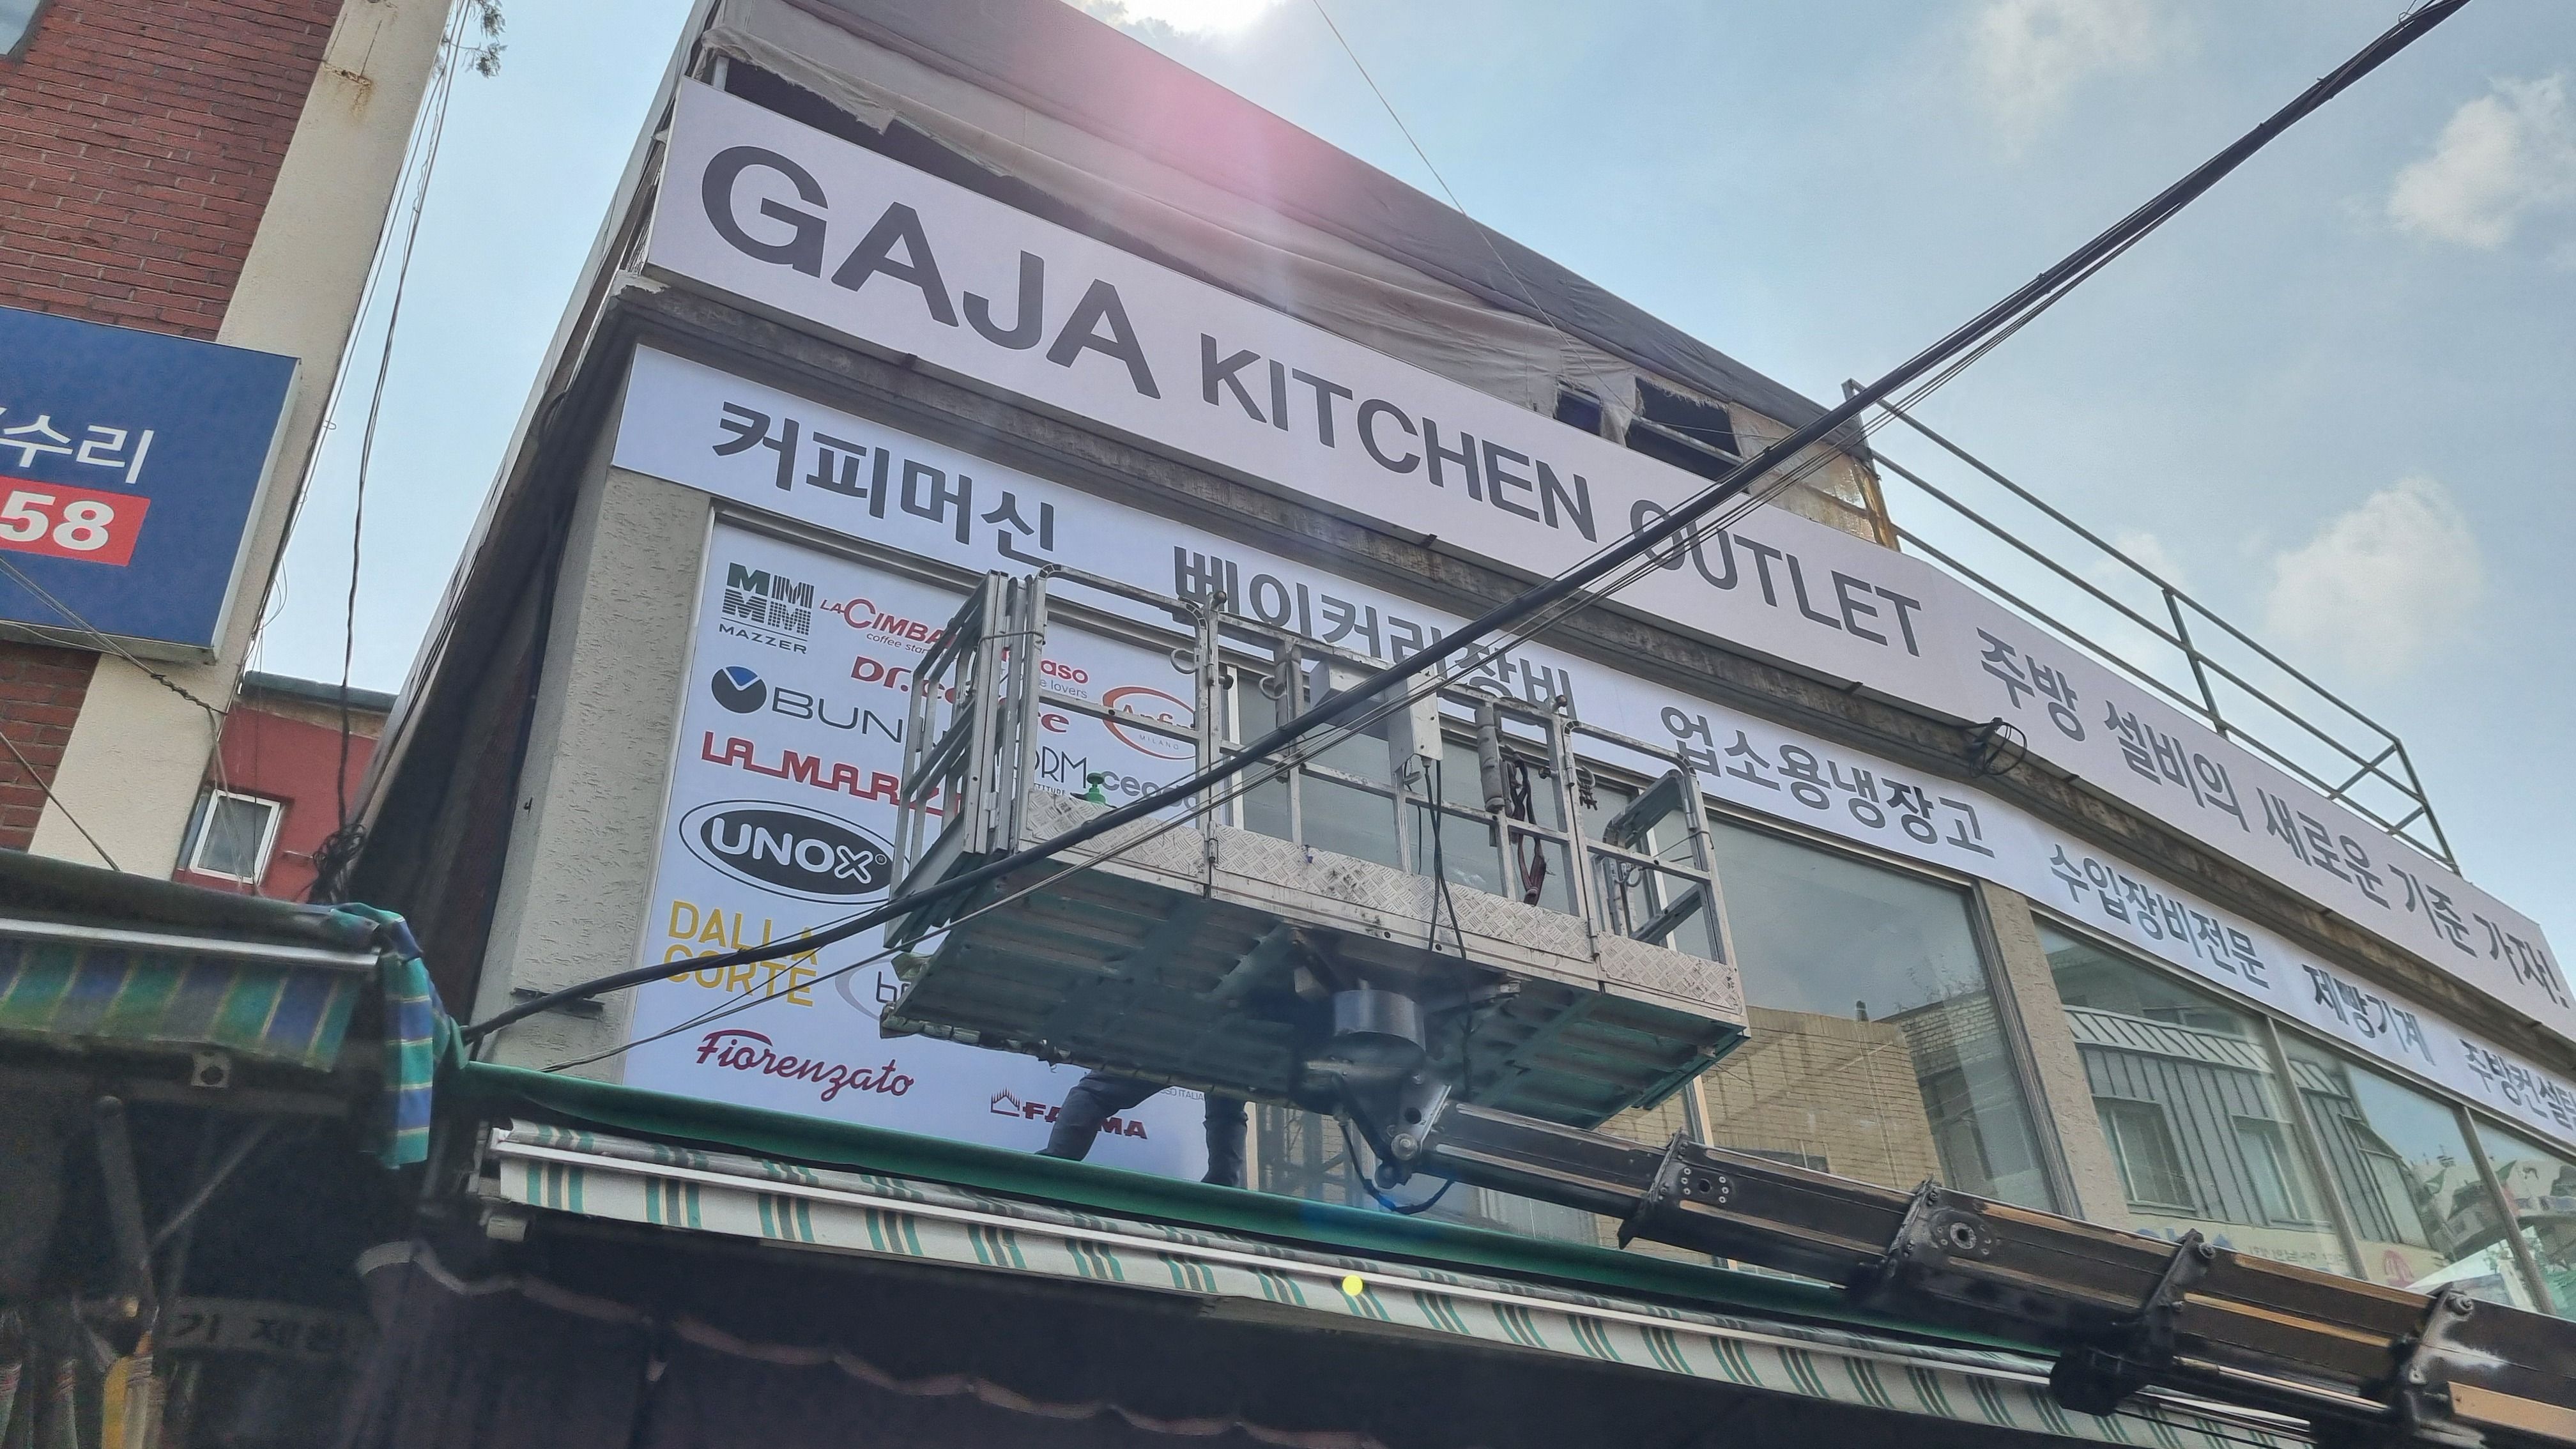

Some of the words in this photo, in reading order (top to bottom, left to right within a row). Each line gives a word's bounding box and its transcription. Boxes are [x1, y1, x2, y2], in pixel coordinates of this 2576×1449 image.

[702, 146, 1162, 400] GAJA
[1200, 332, 1597, 543] KITCHEN
[1630, 499, 1922, 657] OUTLET
[0, 407, 155, 484] 수리
[719, 623, 808, 655] MAZZER
[843, 598, 954, 648] CIMBA
[866, 632, 902, 648] coffee
[905, 643, 931, 656] star
[771, 686, 920, 751] BUN
[1050, 679, 1088, 699] lovers
[712, 401, 1055, 567] 커피머신
[1660, 705, 1996, 859] 업소용냉장고
[2049, 843, 2271, 990] 수입장비전문
[2301, 963, 2436, 1066] 제빵기계
[1977, 627, 2086, 742] 주방
[2104, 700, 2251, 833] 설비의
[2256, 786, 2391, 910] 새로운
[2387, 863, 2478, 958] 기준
[2472, 912, 2570, 1009] 가자!
[663, 944, 818, 1008] CORTE
[696, 1029, 914, 1103] Fiorenzato
[1022, 1101, 1149, 1140] FAMA
